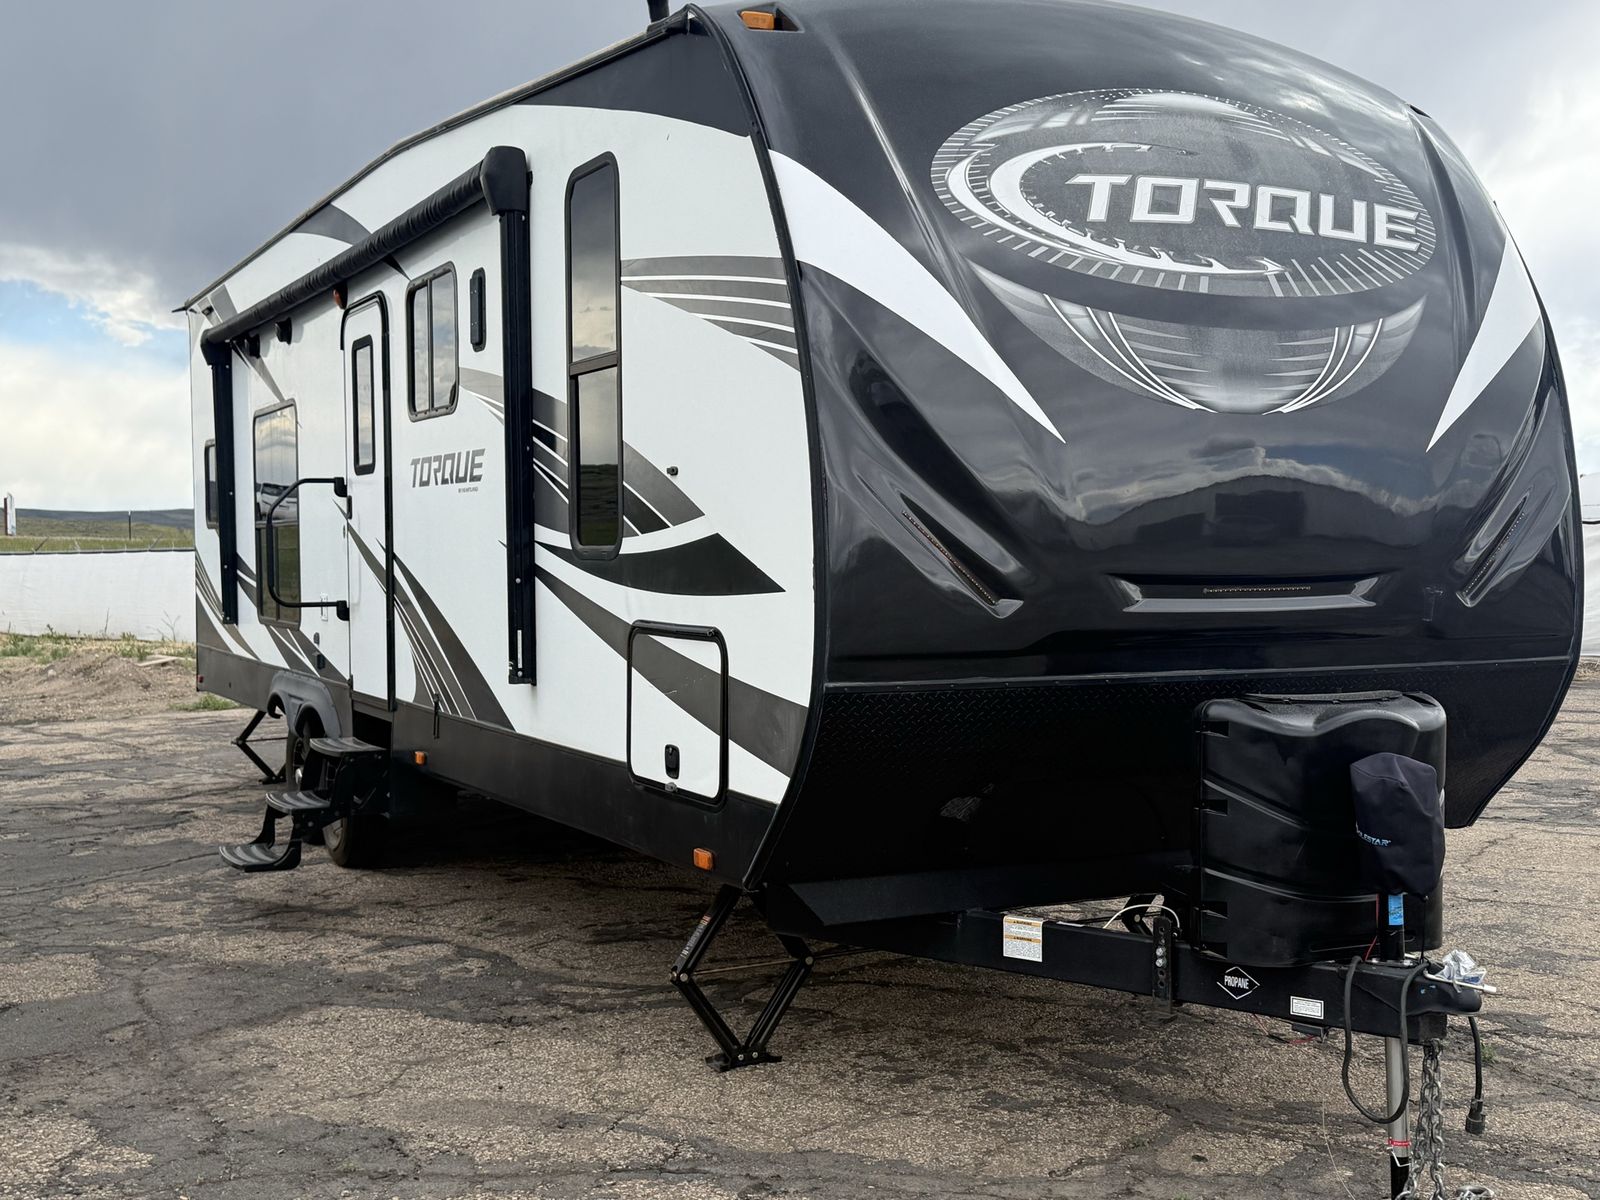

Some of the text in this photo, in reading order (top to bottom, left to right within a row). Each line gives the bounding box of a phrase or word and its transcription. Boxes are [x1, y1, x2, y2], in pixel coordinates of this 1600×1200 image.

[1066, 174, 1420, 251] TORQUE
[410, 448, 486, 488] TORQUE
[1224, 975, 1249, 989] PROPANE
